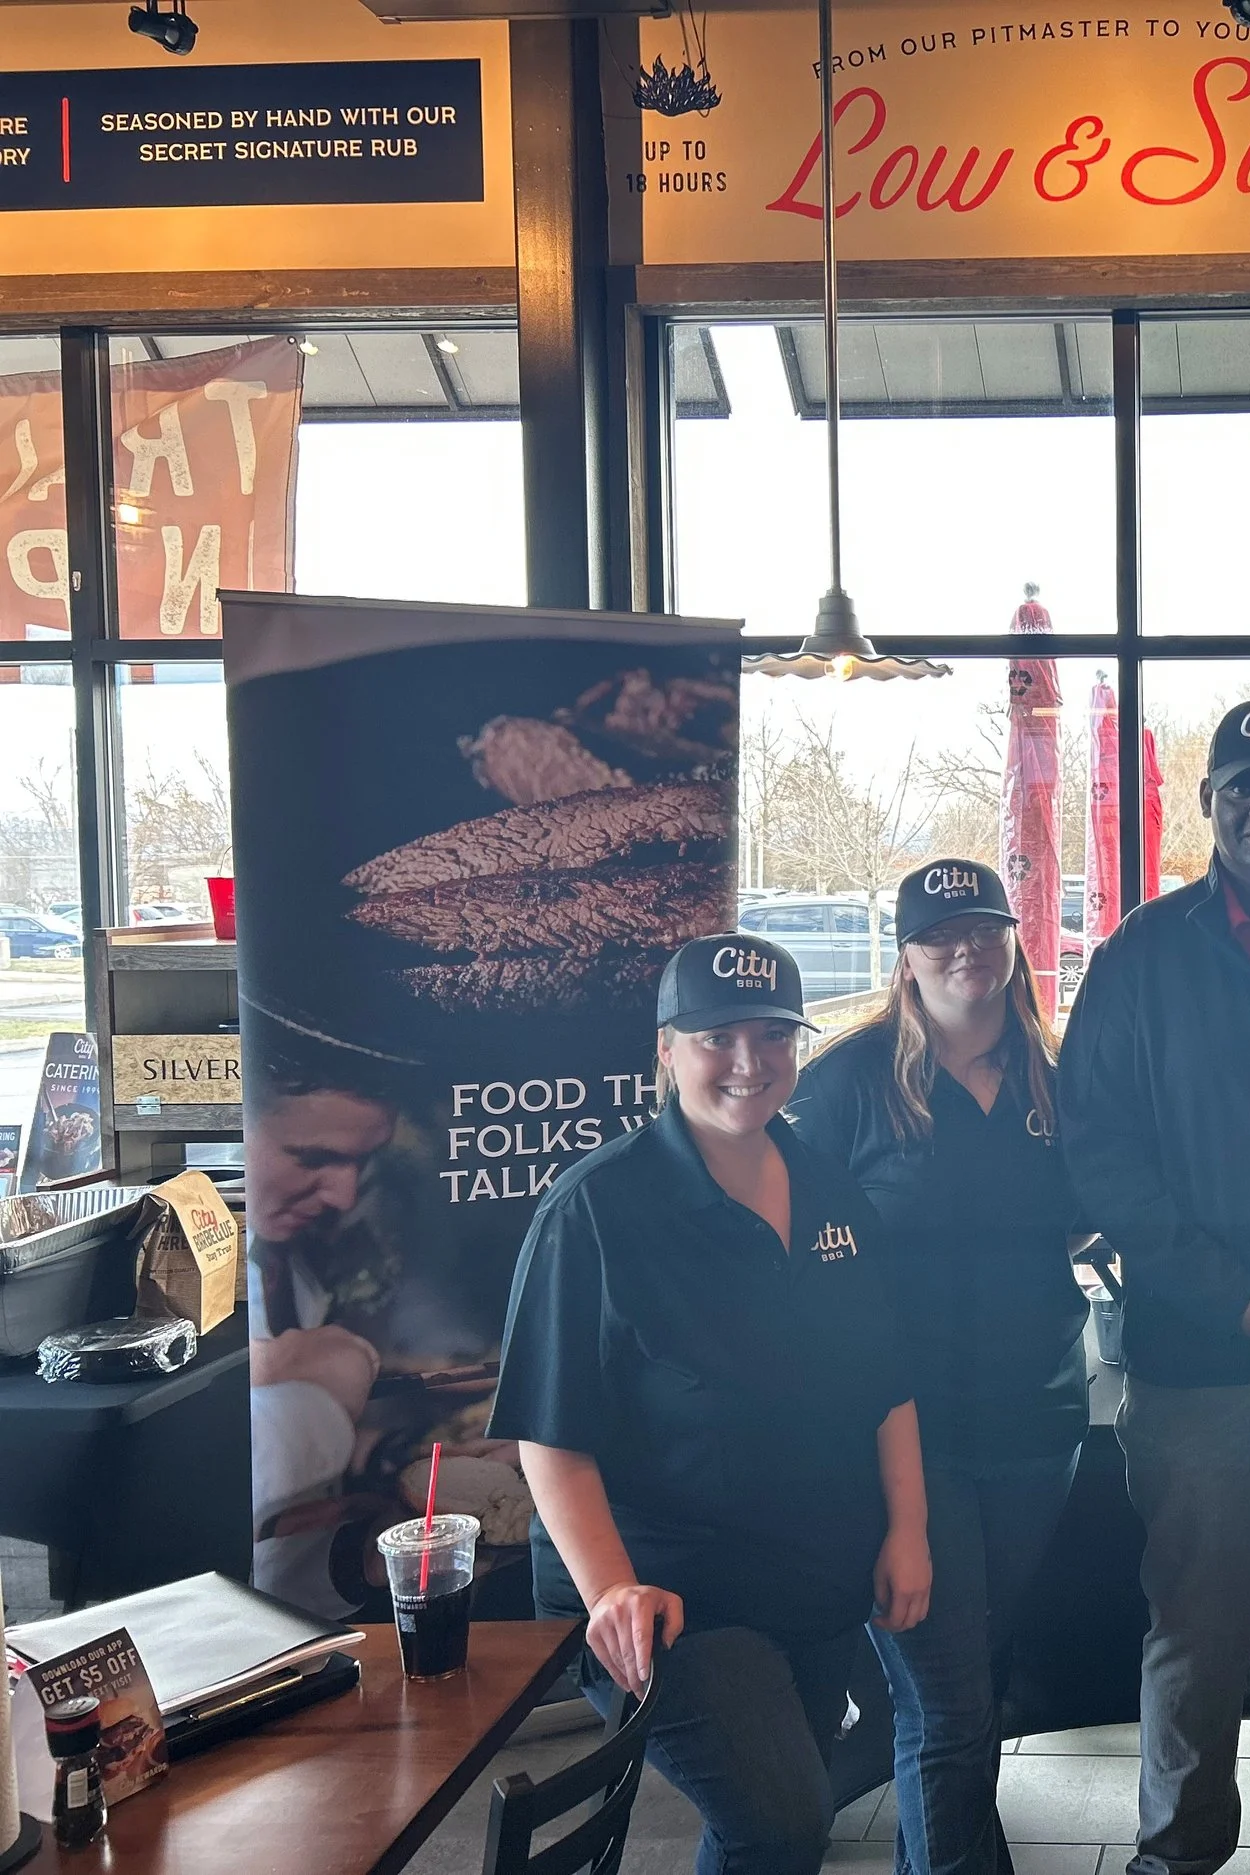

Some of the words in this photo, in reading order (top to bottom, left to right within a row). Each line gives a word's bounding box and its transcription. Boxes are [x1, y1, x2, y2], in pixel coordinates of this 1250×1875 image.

[812, 44, 887, 79] FROM
[900, 32, 957, 56] OUR
[971, 19, 1130, 46] PITMASTER
[1145, 19, 1180, 37] TO
[101, 111, 223, 132] SEASONED
[231, 110, 259, 129] BY
[266, 108, 332, 128] HAND
[340, 107, 398, 126] WITH
[406, 106, 456, 125] OUR
[0, 147, 31, 166] RY
[139, 142, 227, 161] SECRET
[234, 139, 363, 159] SIGNATURE
[371, 138, 418, 156] RUB
[645, 141, 670, 161] UP
[682, 140, 705, 160] TO
[764, 86, 1015, 220] Low
[1033, 115, 1112, 202] &
[626, 173, 647, 193] 18
[659, 172, 727, 193] HOURS
[924, 866, 979, 897] City
[712, 946, 777, 992] City
[736, 979, 763, 988] BBQ
[74, 1038, 94, 1060] City
[45, 1062, 100, 1081] CATERIN
[143, 1058, 241, 1082] SILVER
[51, 1083, 78, 1093] SINCE
[451, 1077, 586, 1118] FOOD
[603, 1073, 657, 1106] TH
[448, 1118, 603, 1161] FOLKS
[191, 1209, 219, 1232] City
[41, 1656, 88, 1682] DOWNLOAD
[87, 1648, 106, 1661] OUR
[106, 1639, 123, 1653] APP
[41, 1677, 74, 1705] GET
[80, 1664, 103, 1689] $5
[107, 1648, 136, 1675] OFF
